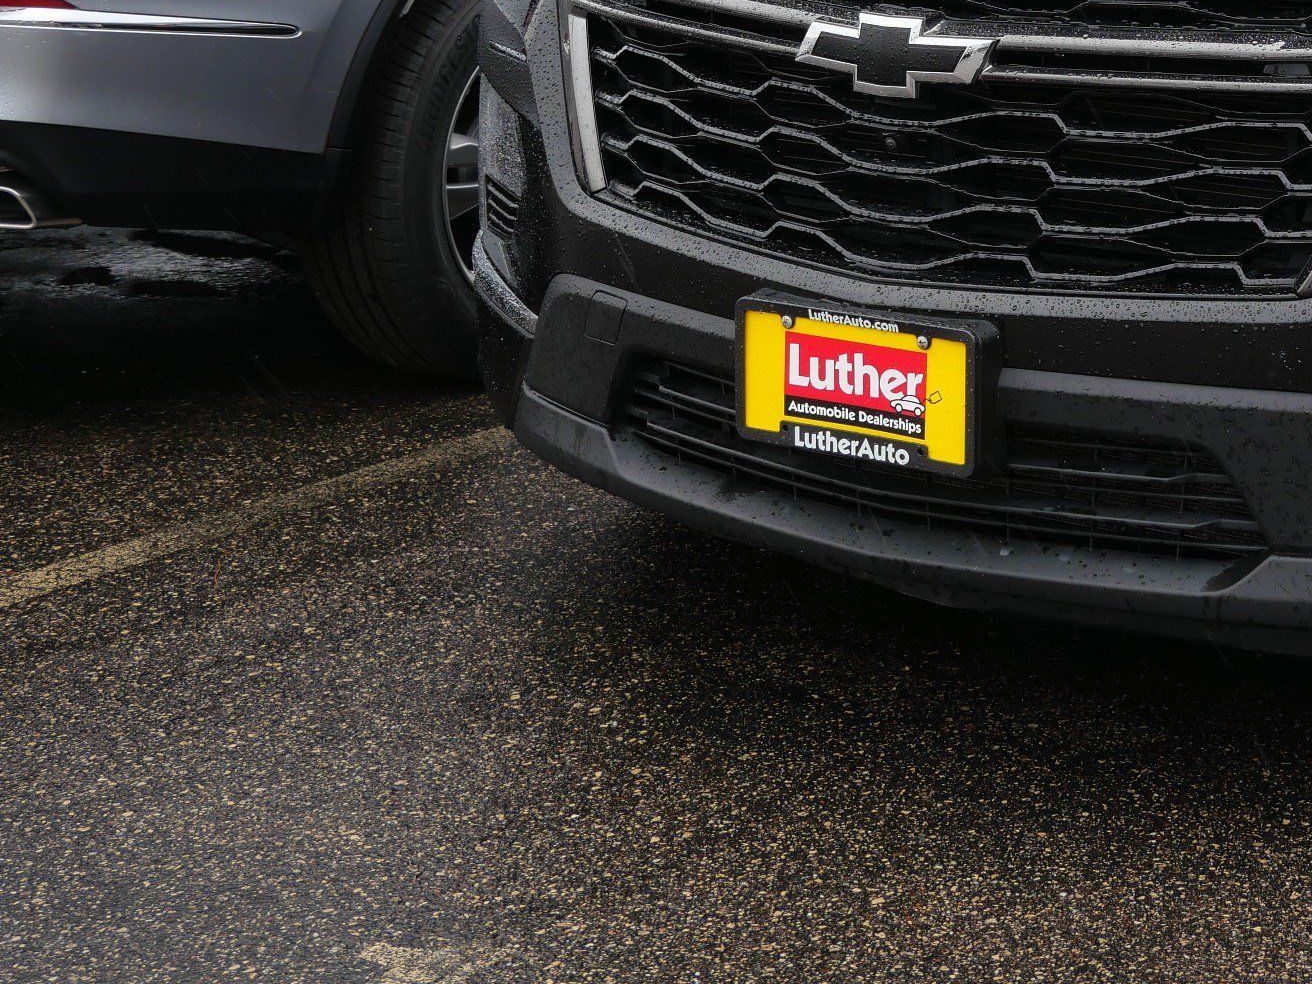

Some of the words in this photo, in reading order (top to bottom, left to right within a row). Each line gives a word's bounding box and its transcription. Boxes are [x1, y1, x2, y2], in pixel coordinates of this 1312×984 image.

[807, 308, 899, 333] LutherAuto.com
[788, 342, 924, 401] Luther
[787, 399, 856, 422] Automobile
[858, 410, 922, 435] Dealerships
[794, 426, 910, 466] LutherAuto
